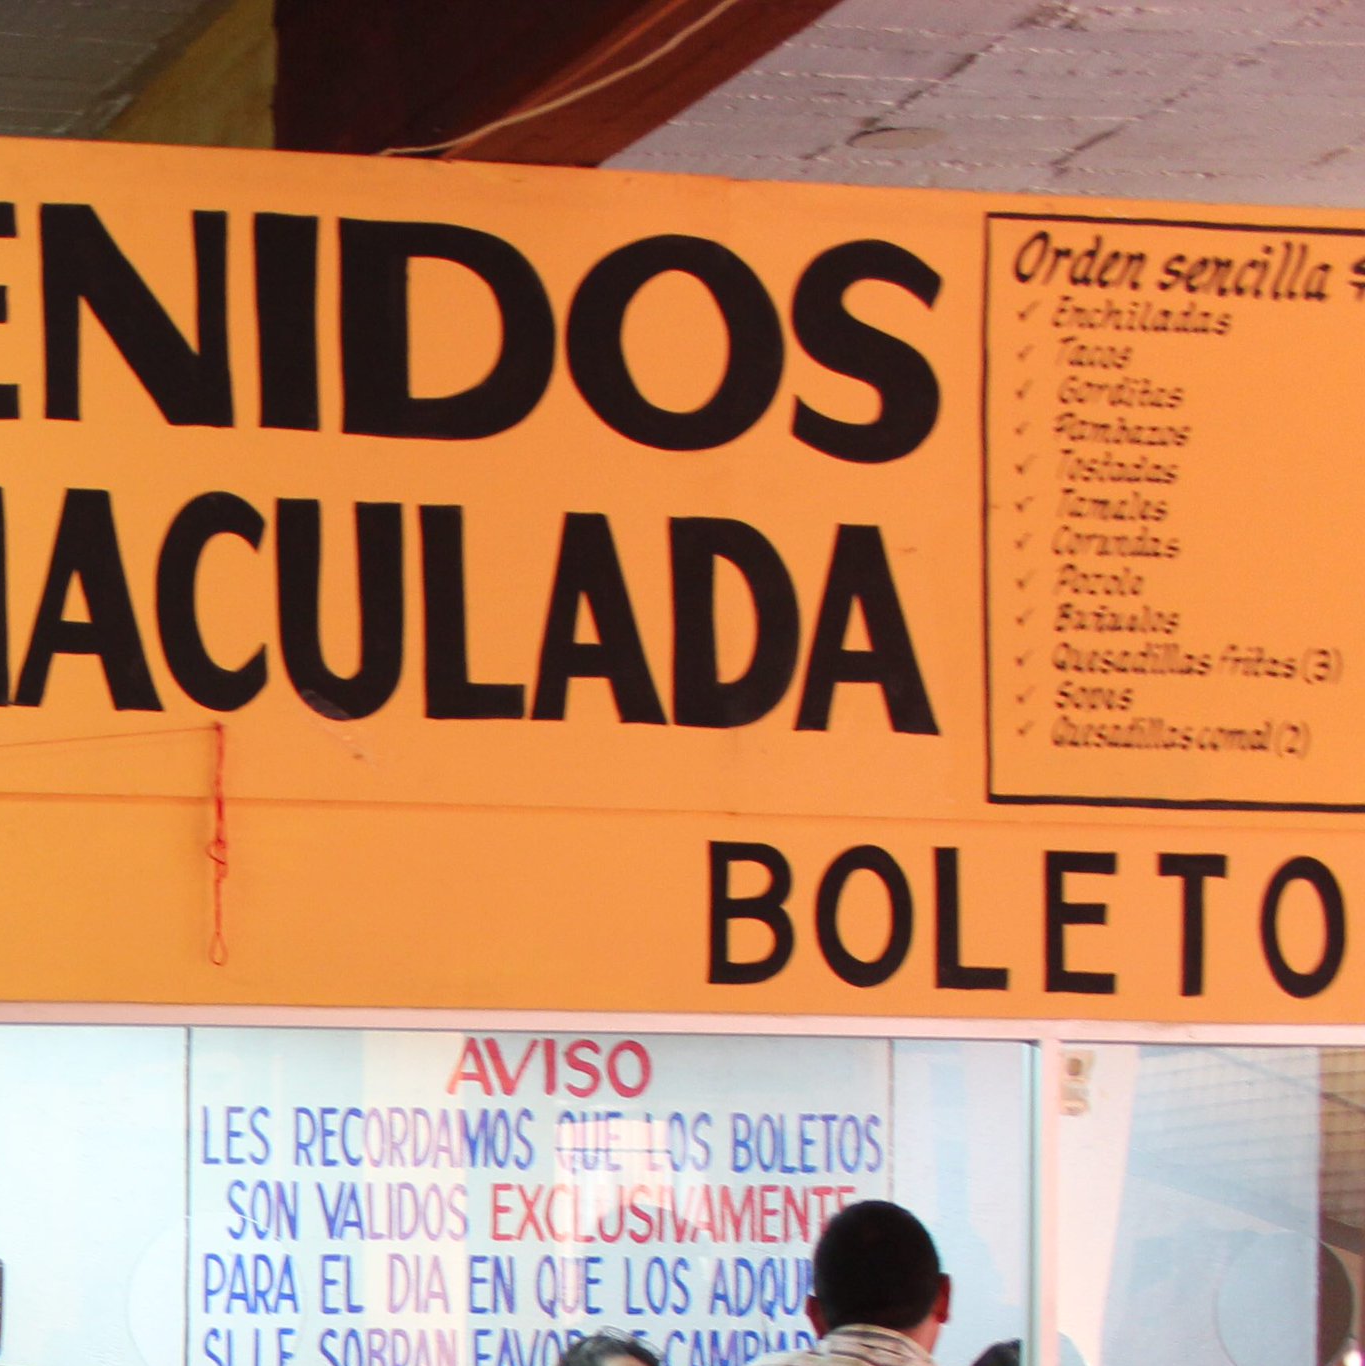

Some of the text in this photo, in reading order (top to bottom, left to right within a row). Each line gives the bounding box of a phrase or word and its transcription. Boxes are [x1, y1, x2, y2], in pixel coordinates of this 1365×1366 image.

[1015, 230, 1147, 291] Orden
[1158, 240, 1333, 301] sencilla
[1051, 295, 1233, 336] Enchiladas
[1055, 336, 1134, 370] Tacos
[1057, 376, 1185, 410] Gorditas
[1056, 448, 1180, 484] Tostadas
[1056, 487, 1169, 521] Tamales
[1051, 524, 1181, 559] Corundas
[1054, 563, 1145, 596] Pozole
[1051, 641, 1212, 676] Quesadillas
[1051, 716, 1193, 751] Quesadillas
[706, 840, 1346, 999] BOLETO
[446, 1037, 654, 1098] AVISO
[201, 1105, 885, 1175] LES RECORDAMOS QUE LOS BOLETOS
[226, 1179, 298, 1241] SON
[315, 1181, 470, 1242] VALIDOS
[203, 1253, 299, 1315] PARA
[321, 1254, 365, 1315] EL
[387, 1254, 451, 1314] DIA
[469, 1254, 516, 1315] EN
[535, 1255, 604, 1319] QUE
[624, 1257, 692, 1315] LOS
